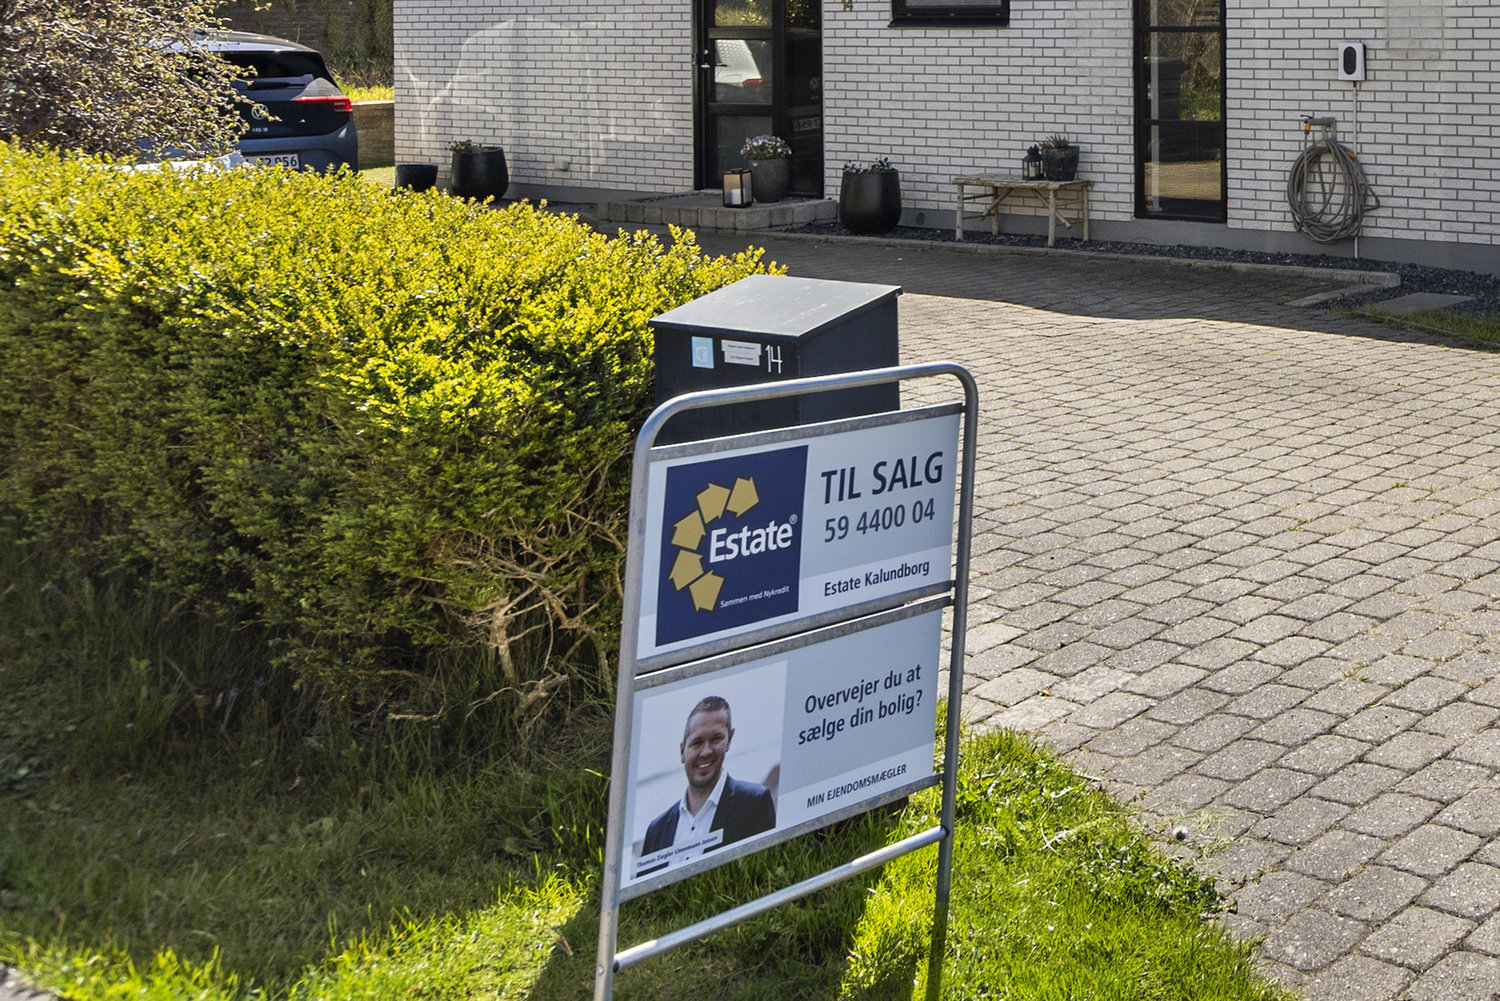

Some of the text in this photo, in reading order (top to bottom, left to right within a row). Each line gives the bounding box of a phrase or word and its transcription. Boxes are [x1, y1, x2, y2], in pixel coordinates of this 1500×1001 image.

[765, 344, 783, 374] 14
[820, 451, 944, 505] TIL SALG
[824, 497, 936, 543] 59 4400 04
[720, 585, 790, 609] Sammen med Nykredit
[824, 560, 931, 597] Estate Kalundborg
[804, 663, 923, 714] Overvejer du at
[797, 688, 924, 746] sælge din bolig?
[806, 763, 908, 809] MIN EJENDOMSMÆGLER
